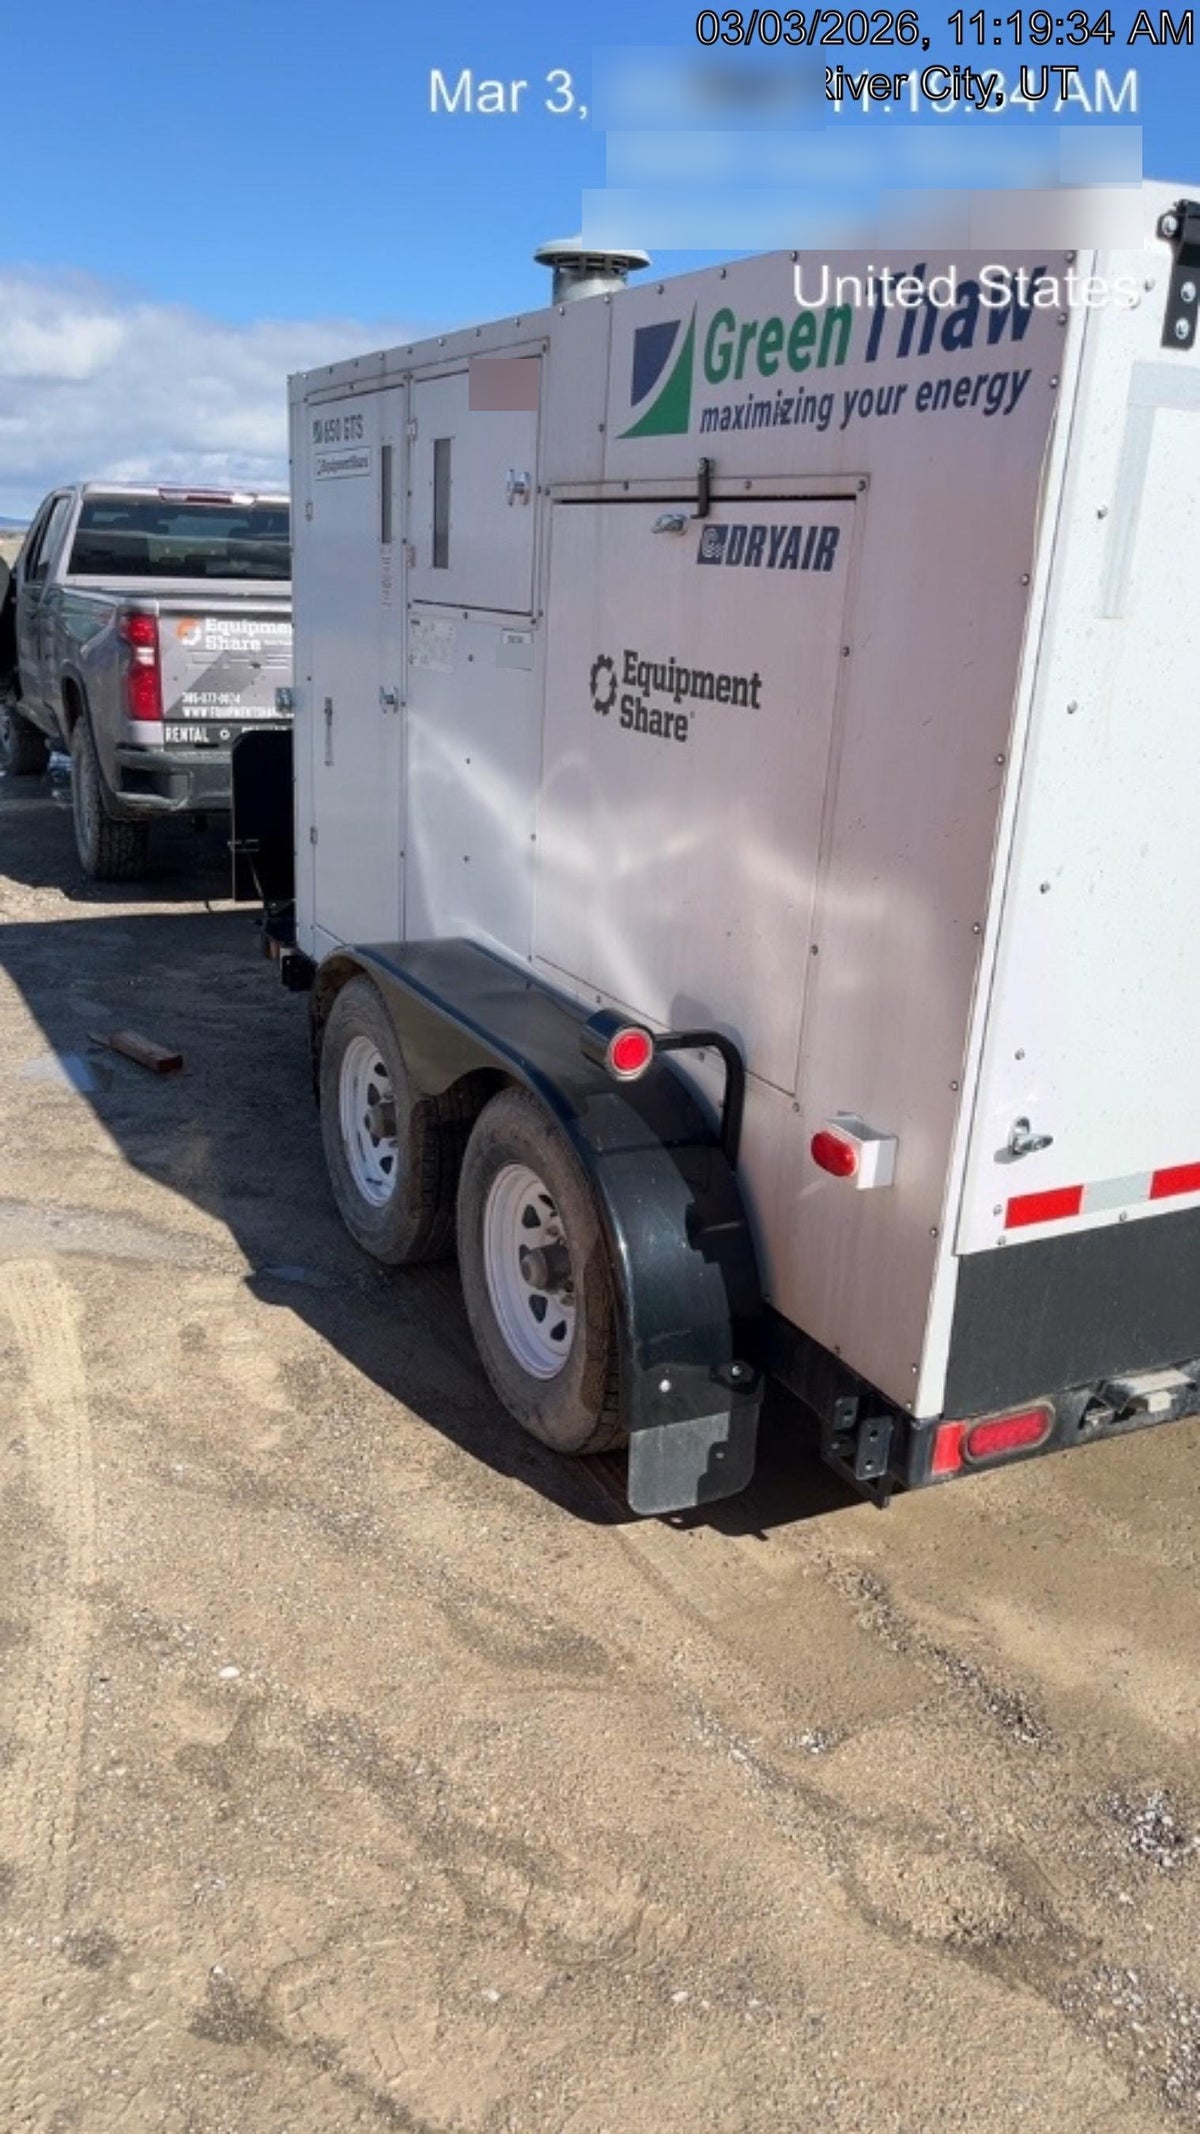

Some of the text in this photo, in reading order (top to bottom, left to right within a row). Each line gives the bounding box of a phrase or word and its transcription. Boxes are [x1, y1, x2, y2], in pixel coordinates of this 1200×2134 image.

[699, 368, 1032, 435] maximizing your energy
[725, 524, 841, 572] DRYAIR
[205, 619, 293, 637] Equipme
[622, 649, 763, 710] Equipment
[164, 727, 209, 743] RENTAL
[619, 694, 689, 743] Share
